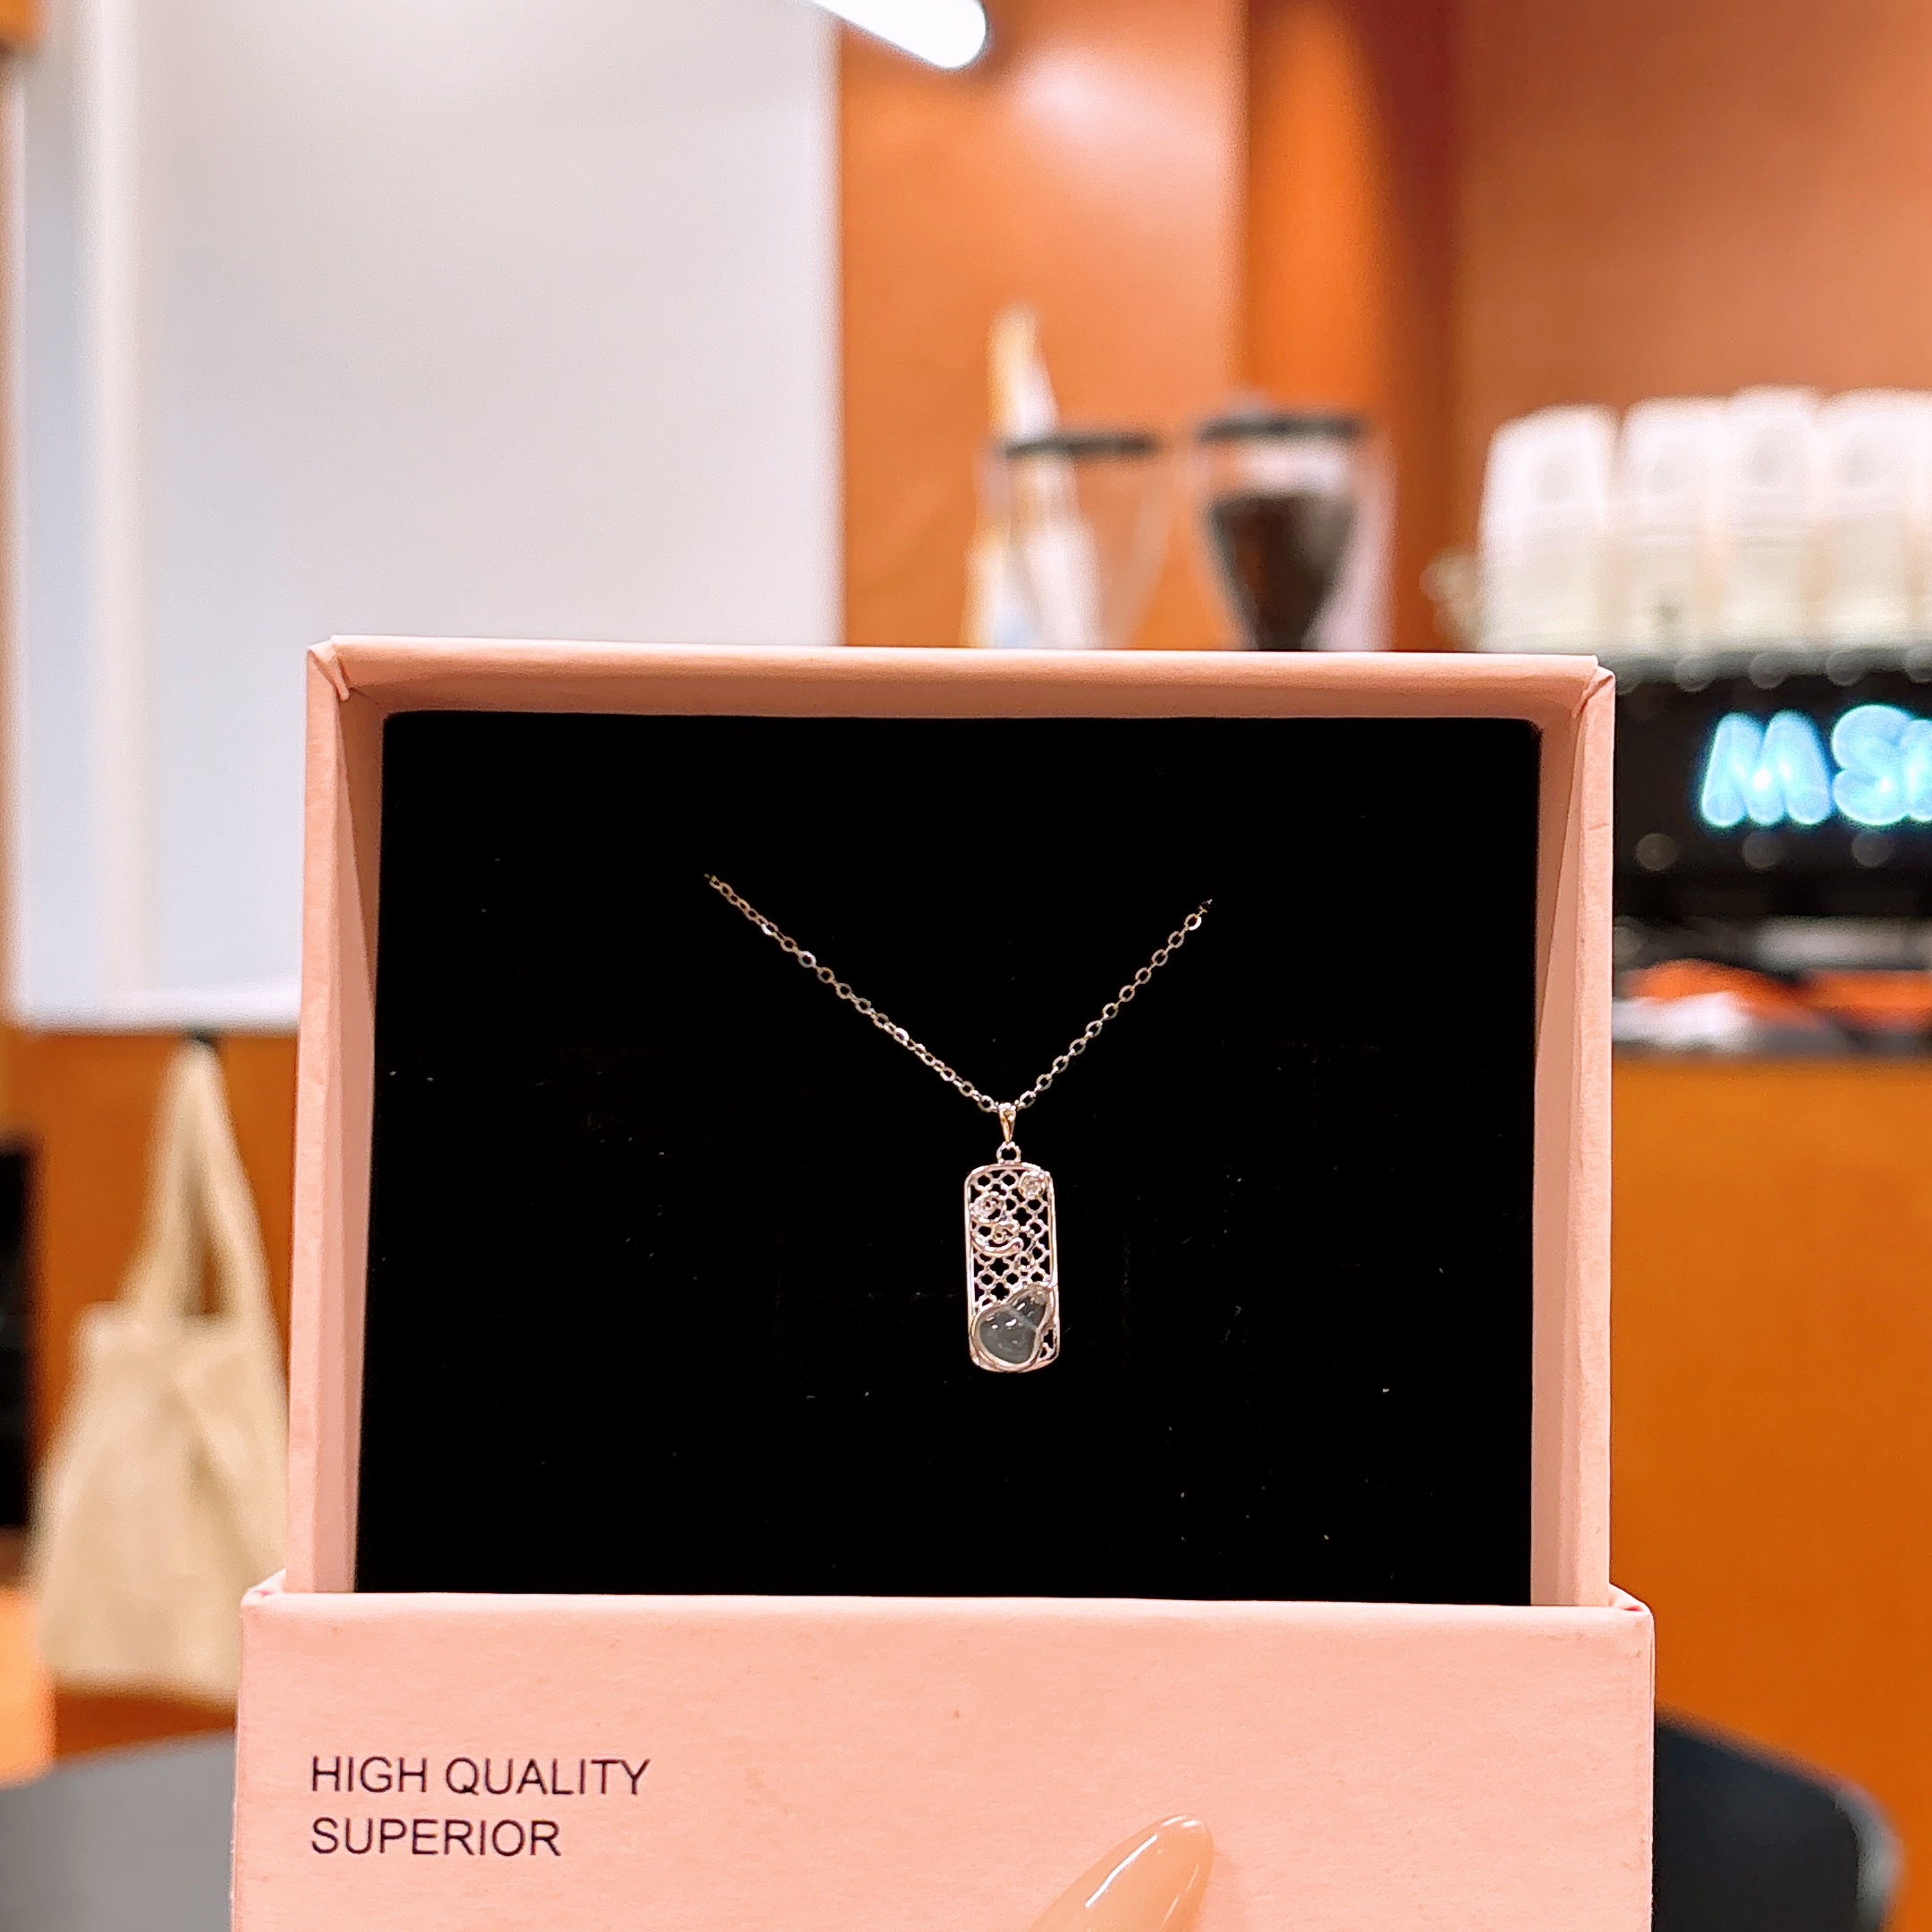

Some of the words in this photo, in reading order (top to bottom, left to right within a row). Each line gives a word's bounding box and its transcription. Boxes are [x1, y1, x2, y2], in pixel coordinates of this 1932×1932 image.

[310, 1755, 428, 1793] HIGH
[445, 1756, 650, 1796] QUALITY
[310, 1817, 562, 1857] SUPERIOR
